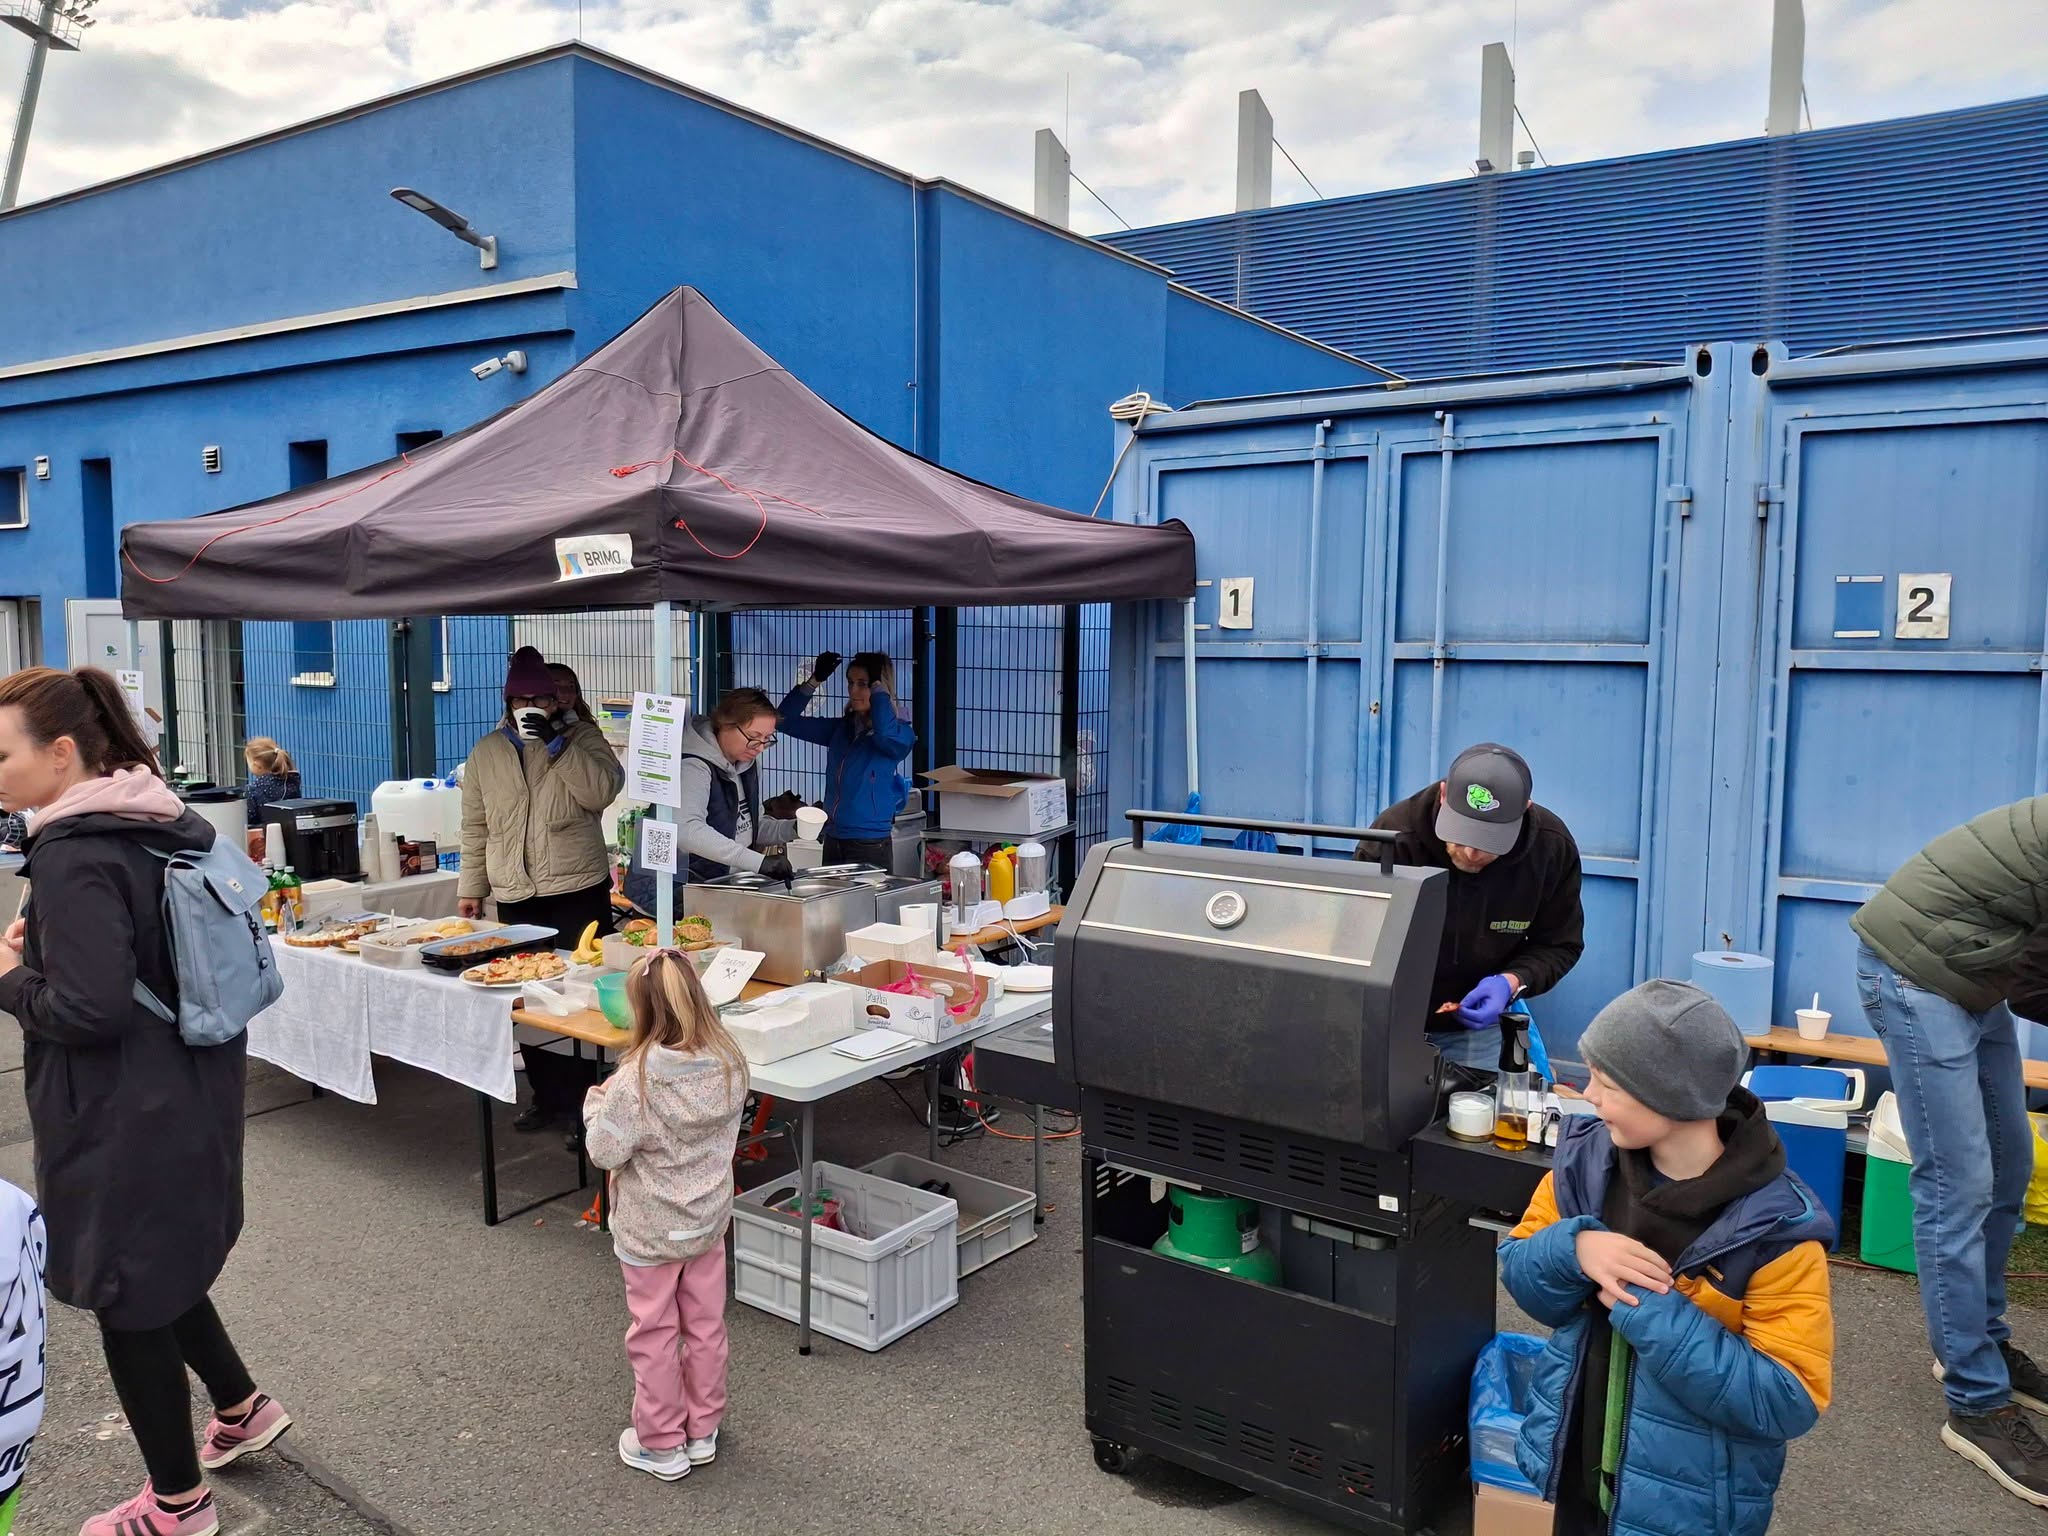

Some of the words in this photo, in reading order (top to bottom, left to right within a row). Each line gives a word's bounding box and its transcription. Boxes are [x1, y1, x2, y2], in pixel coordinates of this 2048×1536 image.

[584, 550, 622, 567] BRIMO
[1229, 588, 1240, 617] 1
[1907, 587, 1935, 623] 2
